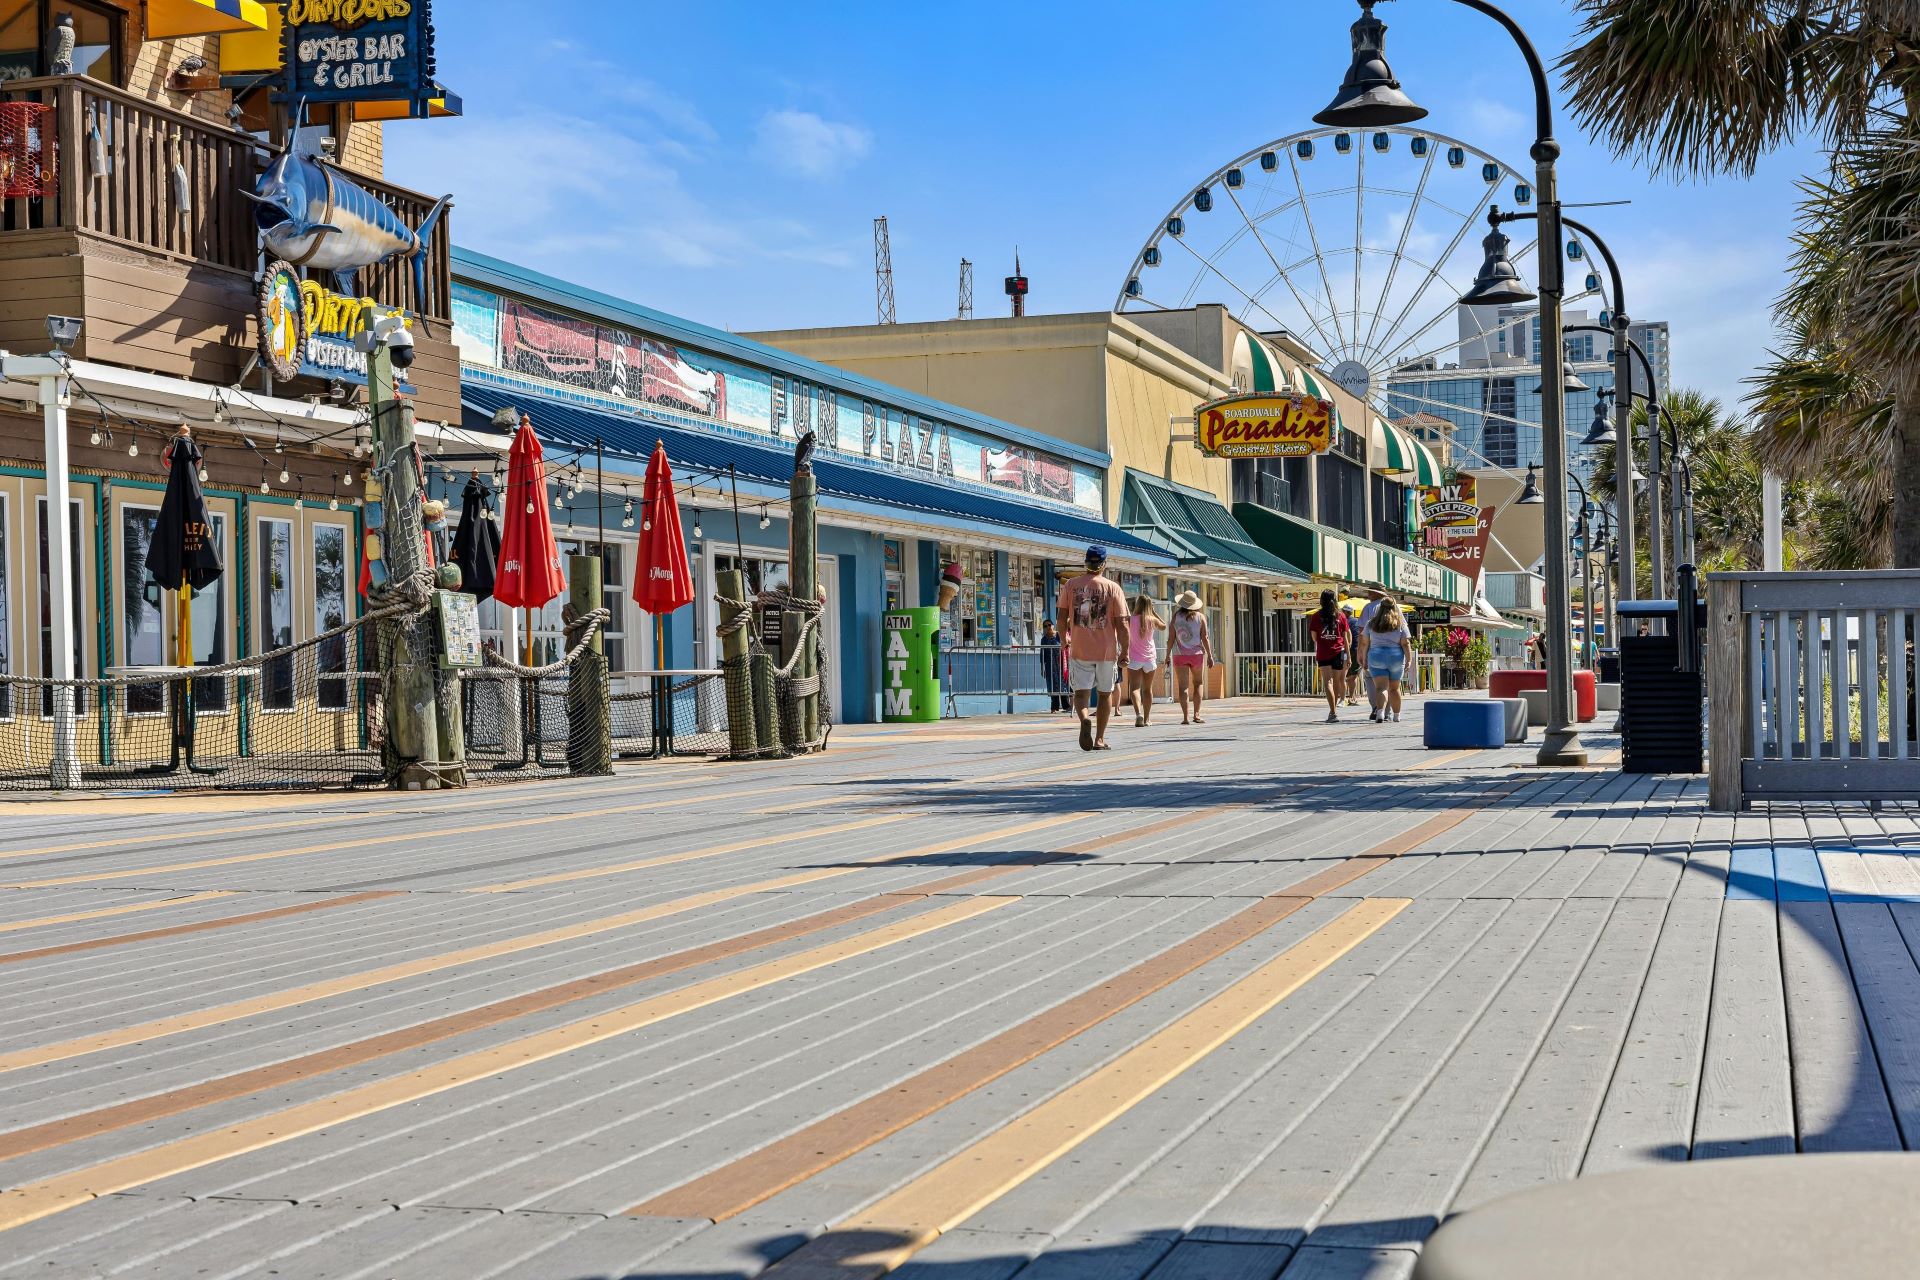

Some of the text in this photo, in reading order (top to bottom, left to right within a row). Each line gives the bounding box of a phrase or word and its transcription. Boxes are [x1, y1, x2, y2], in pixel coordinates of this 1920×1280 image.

[298, 33, 406, 62] OYSTER BAR
[313, 61, 394, 88] & GRILL
[1224, 407, 1281, 419] BOARDWALK
[770, 371, 838, 450] FUN
[863, 399, 954, 478] PLAZA
[1206, 402, 1328, 450] Paradise
[1222, 444, 1307, 456] General Store
[1440, 485, 1463, 501] N.Y.
[1424, 503, 1477, 517] STYLE PIZZA
[886, 616, 911, 629] ATM
[884, 630, 913, 716] ATM
